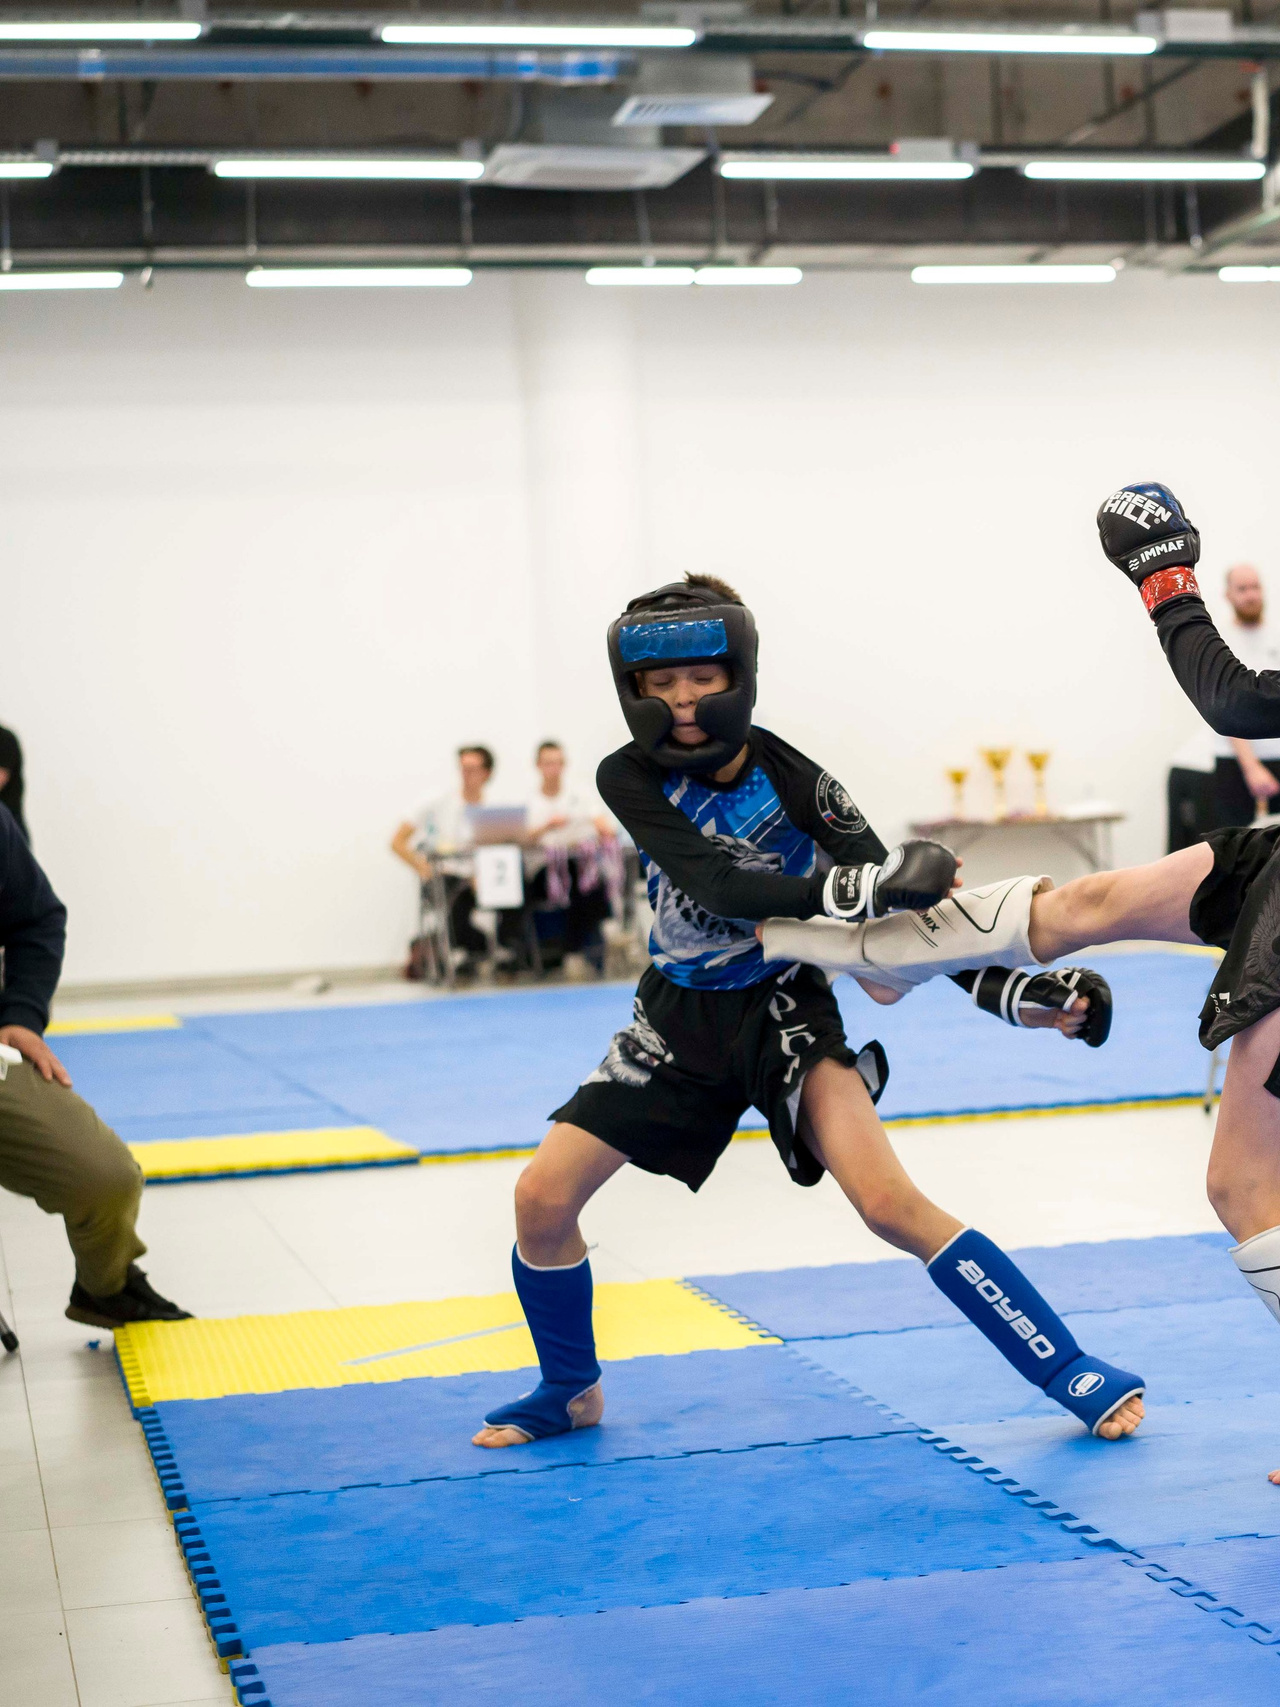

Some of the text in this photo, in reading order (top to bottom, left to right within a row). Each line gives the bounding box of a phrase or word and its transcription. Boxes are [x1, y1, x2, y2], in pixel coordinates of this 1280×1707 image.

[1103, 499, 1151, 530] HILL
[1109, 491, 1172, 523] GREEN
[1140, 540, 1185, 563] IMMAF
[956, 1259, 1056, 1360] BOYBO
